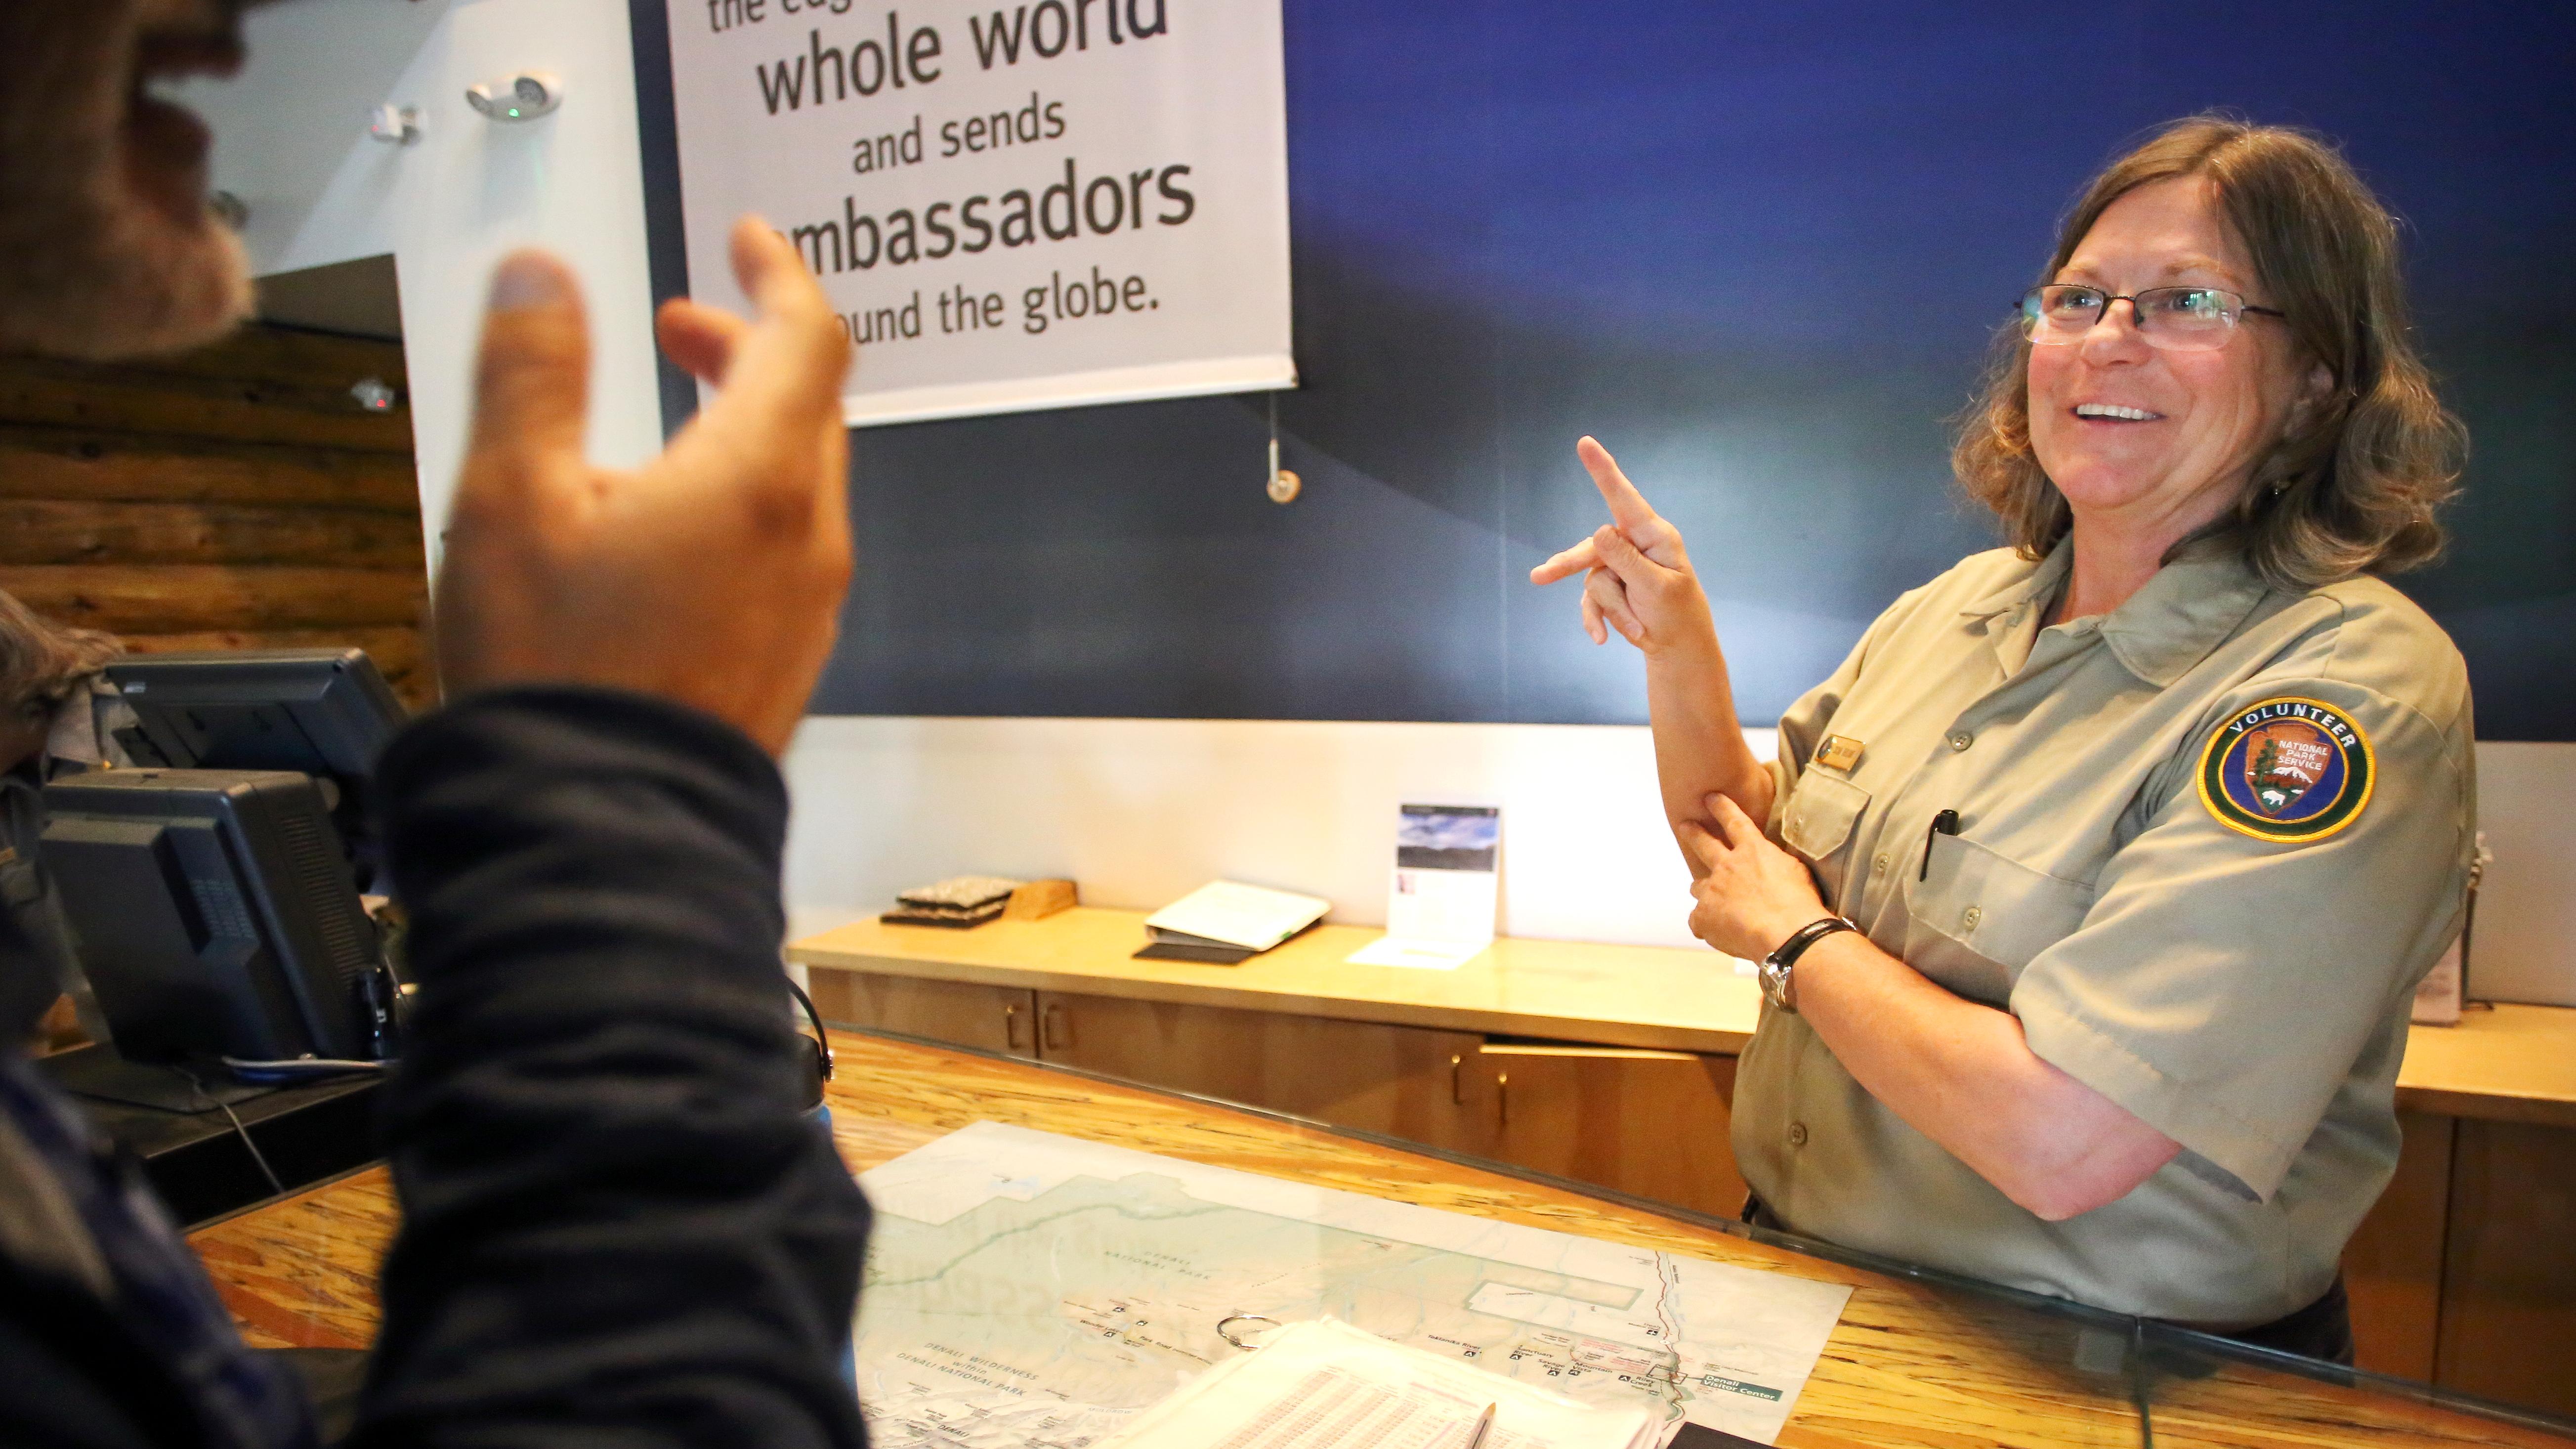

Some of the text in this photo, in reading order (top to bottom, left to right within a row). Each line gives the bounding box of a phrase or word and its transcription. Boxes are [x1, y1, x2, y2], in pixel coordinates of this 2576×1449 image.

[756, 12, 942, 116] whole
[852, 91, 1066, 174] and sends
[774, 157, 1196, 276] mbassadors
[833, 266, 1160, 345] ound the globe.
[2229, 703, 2356, 748] VOLUNTEER
[2279, 740, 2327, 756] NATIONAL
[2286, 749, 2316, 761] PARK
[2278, 755, 2322, 771] SERVICE
[1428, 1334, 1460, 1346] Teklanika
[1518, 1346, 1554, 1358] Sanctuary
[924, 1342, 1040, 1381] DENALI WILDERNESS
[952, 1361, 987, 1375] within
[1538, 1359, 1565, 1368] Savage
[1574, 1362, 1613, 1374] Mountain
[896, 1352, 937, 1368] DENALI
[938, 1365, 993, 1386] NATIONAL
[995, 1383, 1027, 1397] PARK
[1706, 1375, 1739, 1387] Denali
[1704, 1379, 1738, 1392] Visitor
[1739, 1388, 1775, 1400] Center
[937, 1424, 971, 1438] DENALI
